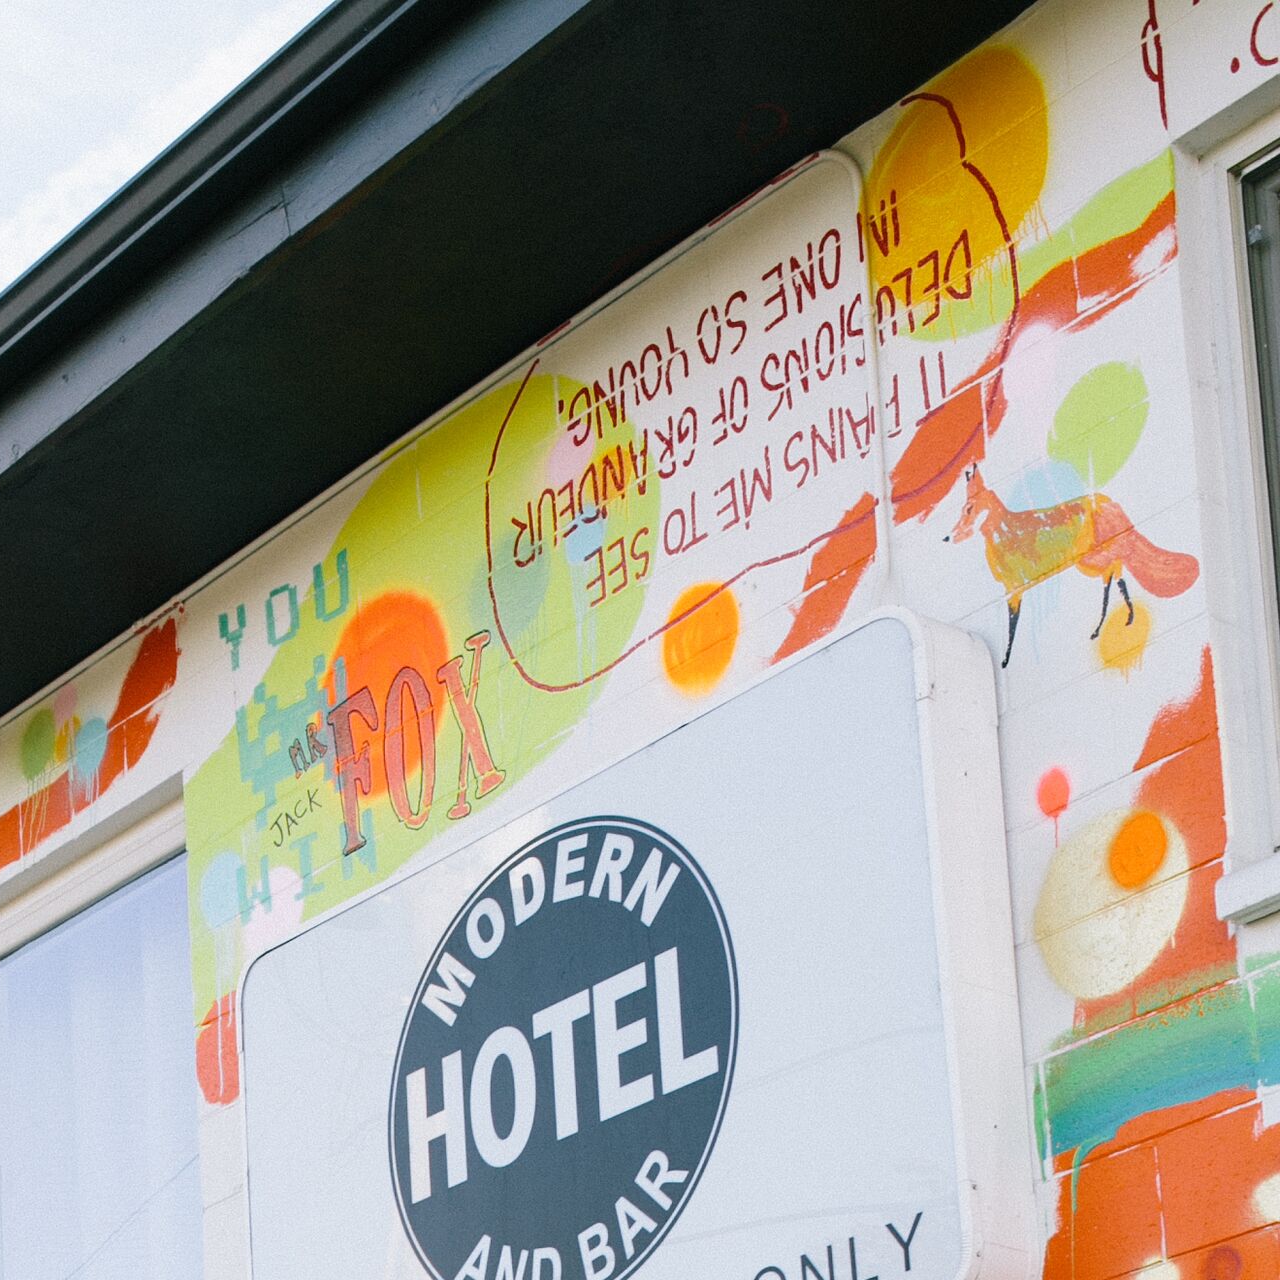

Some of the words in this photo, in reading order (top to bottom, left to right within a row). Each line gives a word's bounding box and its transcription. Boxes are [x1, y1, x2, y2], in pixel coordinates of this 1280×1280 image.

[856, 189, 901, 263] IN
[761, 229, 842, 332] ONE
[696, 291, 748, 364] SO
[760, 229, 973, 422] DELUSIONS
[713, 376, 748, 445] OF
[916, 351, 946, 426] IT
[511, 406, 697, 568] GRANDEUR
[663, 491, 709, 555] TO
[715, 445, 772, 531] ME
[218, 548, 349, 671] YOU
[584, 527, 651, 607] SEE
[328, 629, 506, 857] FOX
[270, 788, 322, 847] JACK
[421, 832, 681, 1026] MODERN
[405, 947, 719, 1204] HOTEL
